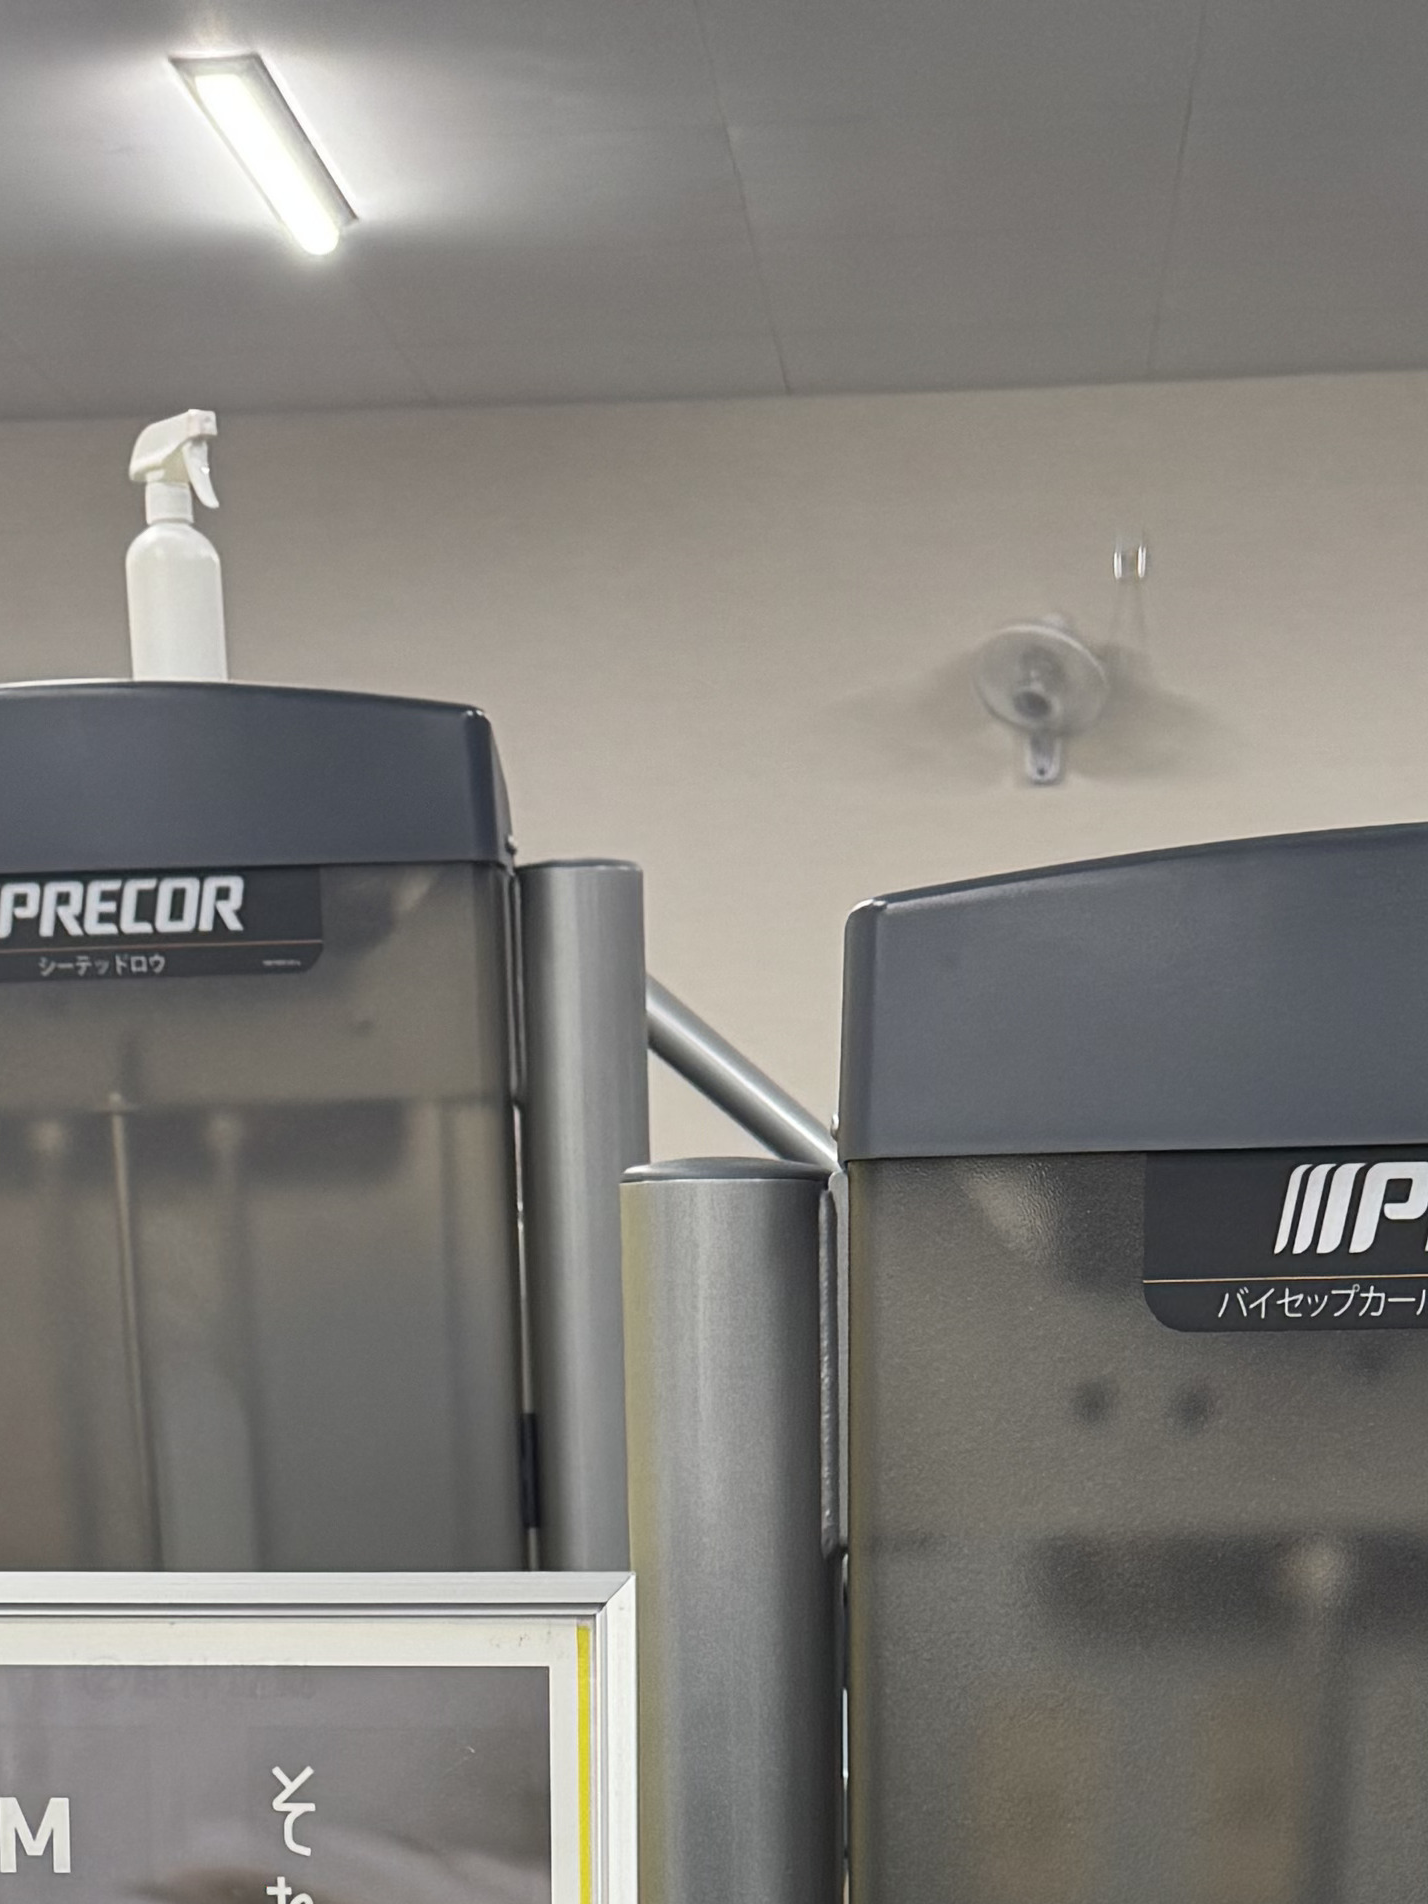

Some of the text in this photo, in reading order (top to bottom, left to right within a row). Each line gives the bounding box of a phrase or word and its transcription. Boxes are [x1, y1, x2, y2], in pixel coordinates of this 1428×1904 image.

[38, 954, 166, 977] シーテッドロウ
